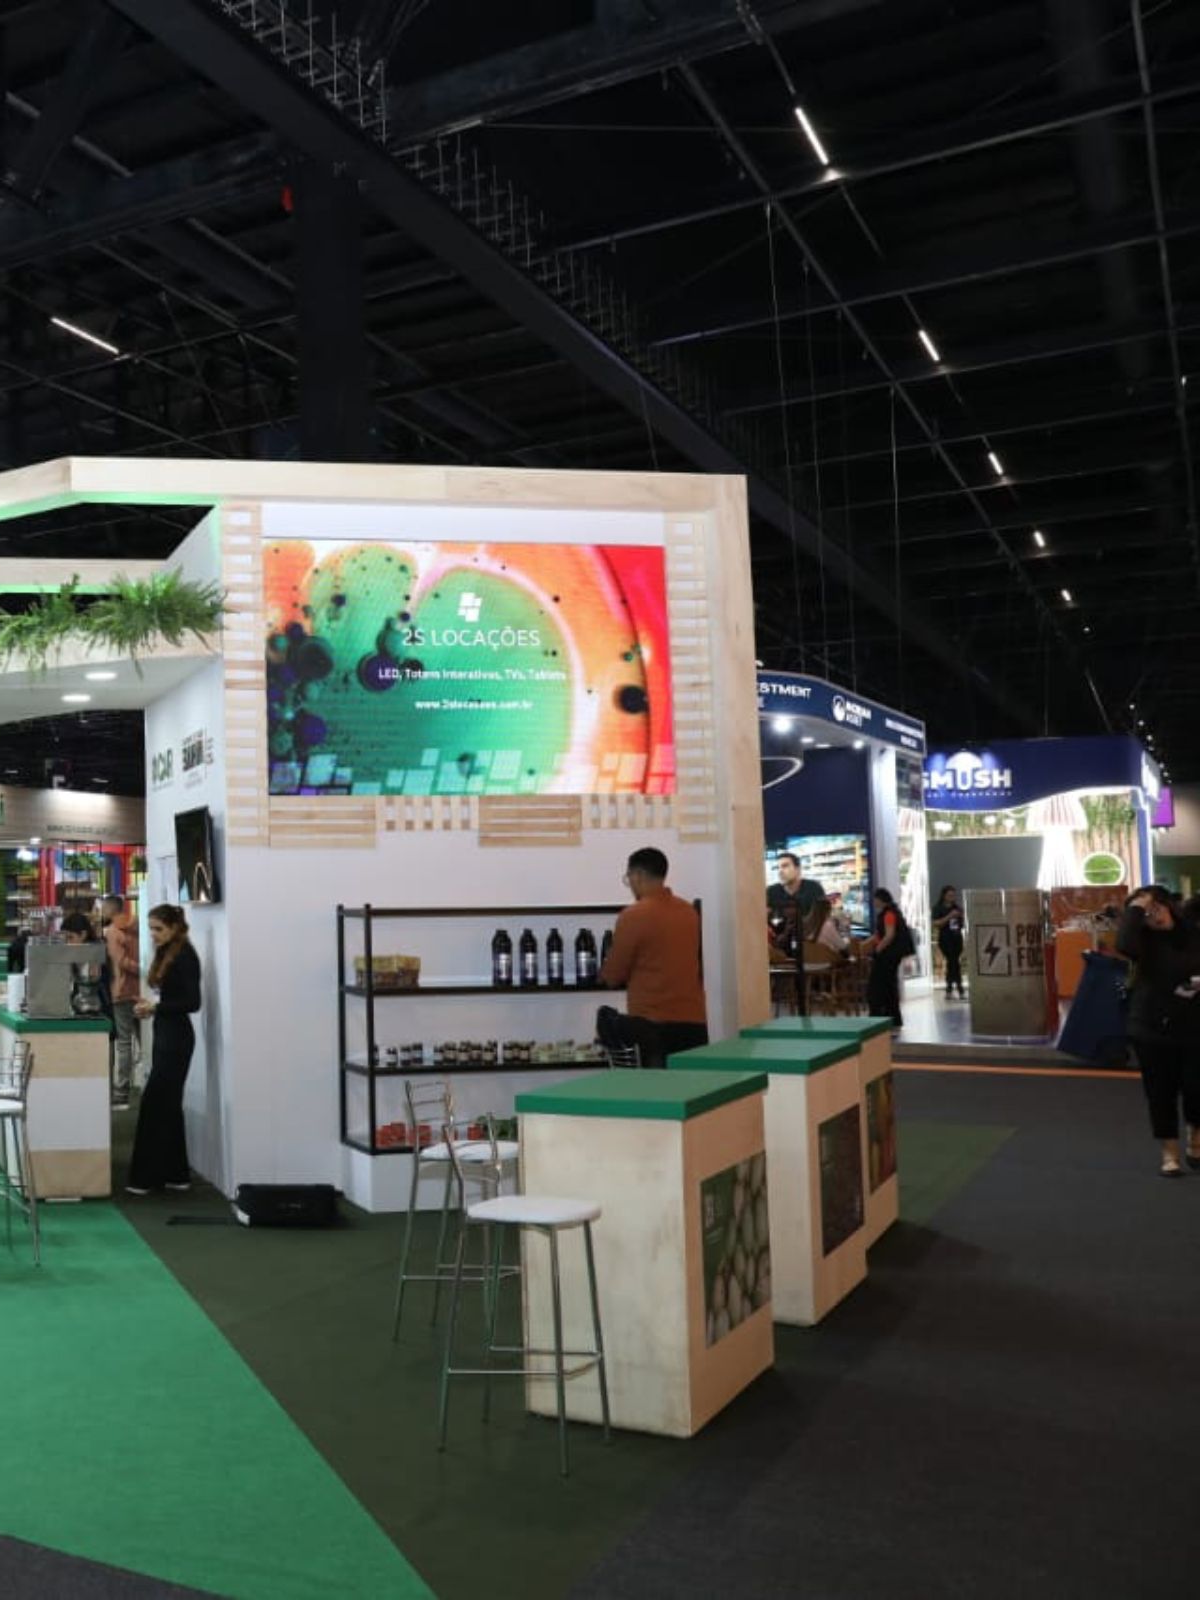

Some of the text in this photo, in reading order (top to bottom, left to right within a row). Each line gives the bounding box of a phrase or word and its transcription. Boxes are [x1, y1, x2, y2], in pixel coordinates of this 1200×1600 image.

[402, 626, 541, 651] 2S LOCAÇÕES
[757, 682, 812, 700] STMENT
